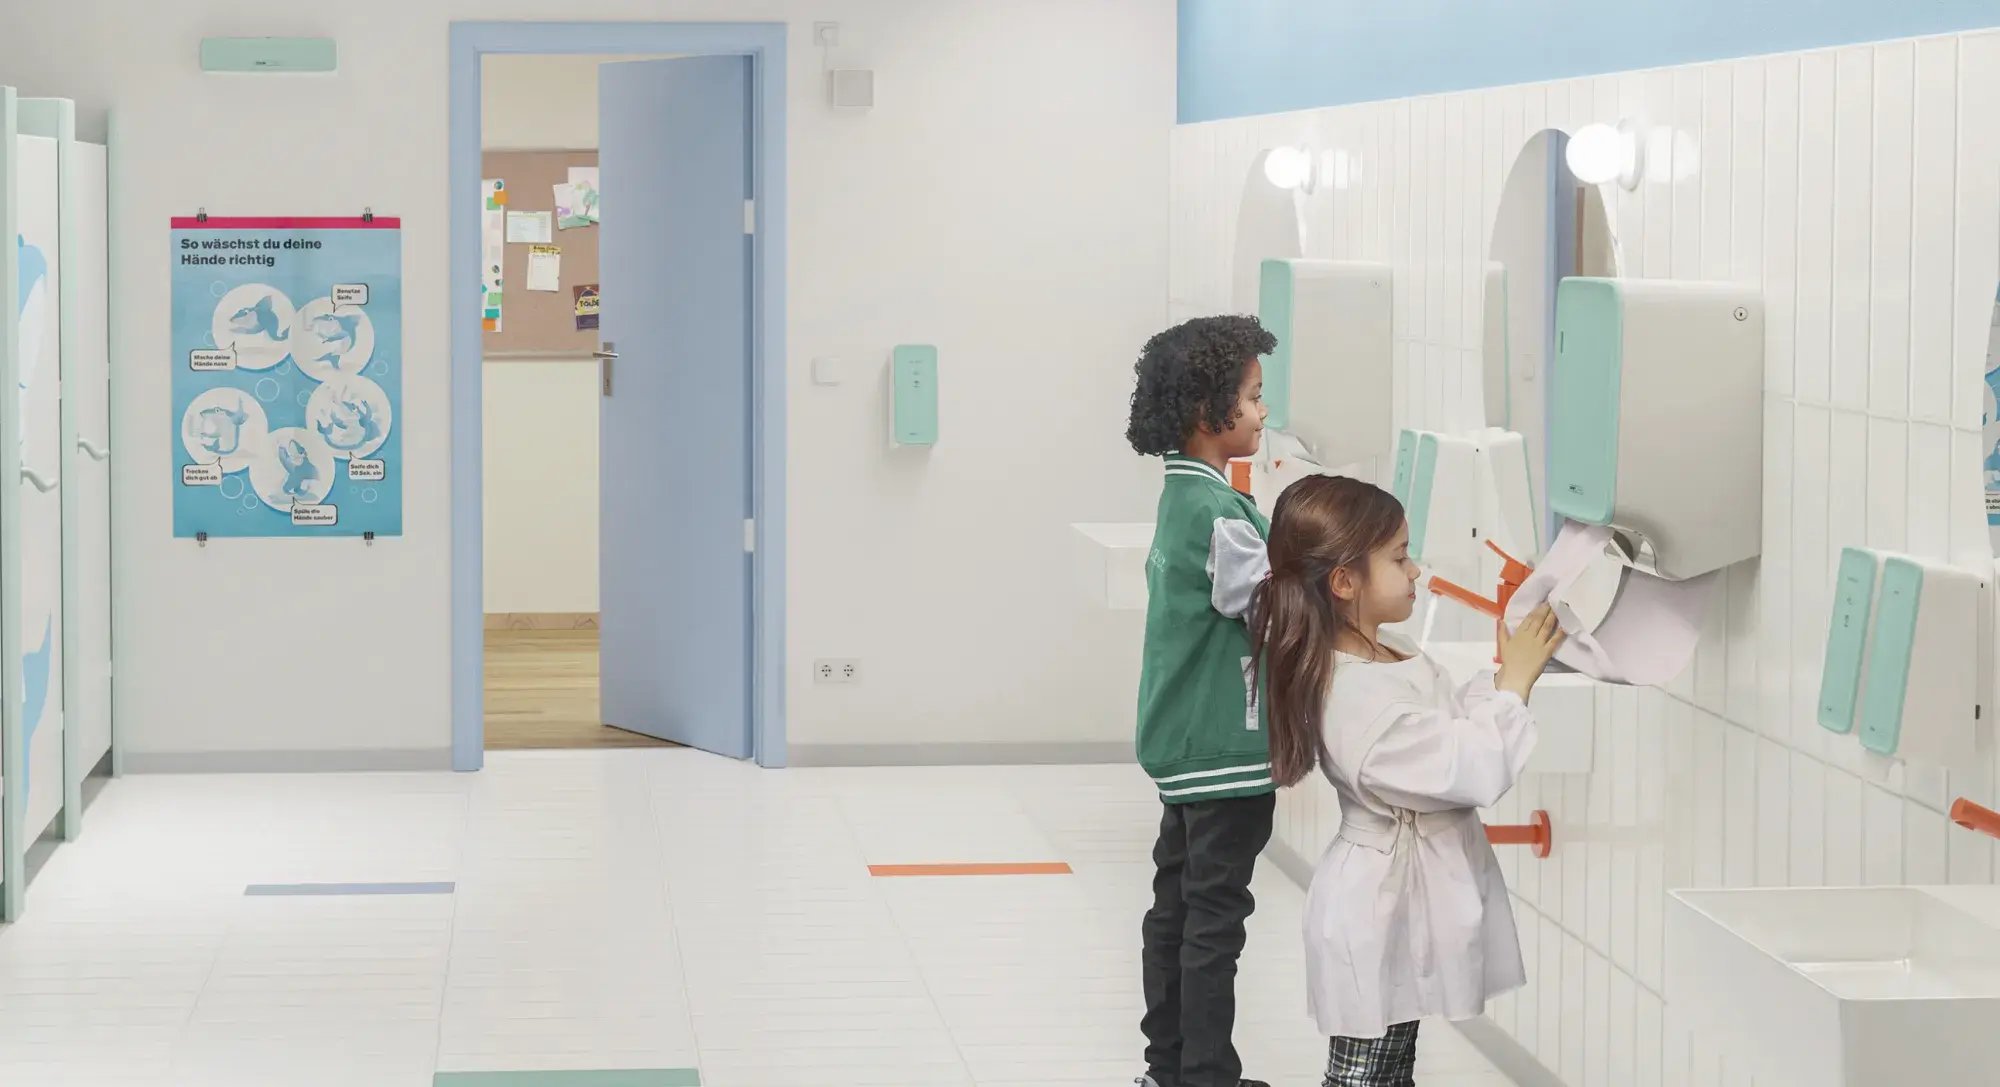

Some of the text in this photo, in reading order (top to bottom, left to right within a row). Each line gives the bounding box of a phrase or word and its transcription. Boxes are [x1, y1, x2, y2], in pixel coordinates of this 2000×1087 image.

[180, 239, 322, 249] So wäschst du deine
[181, 254, 275, 267] Hände richtig
